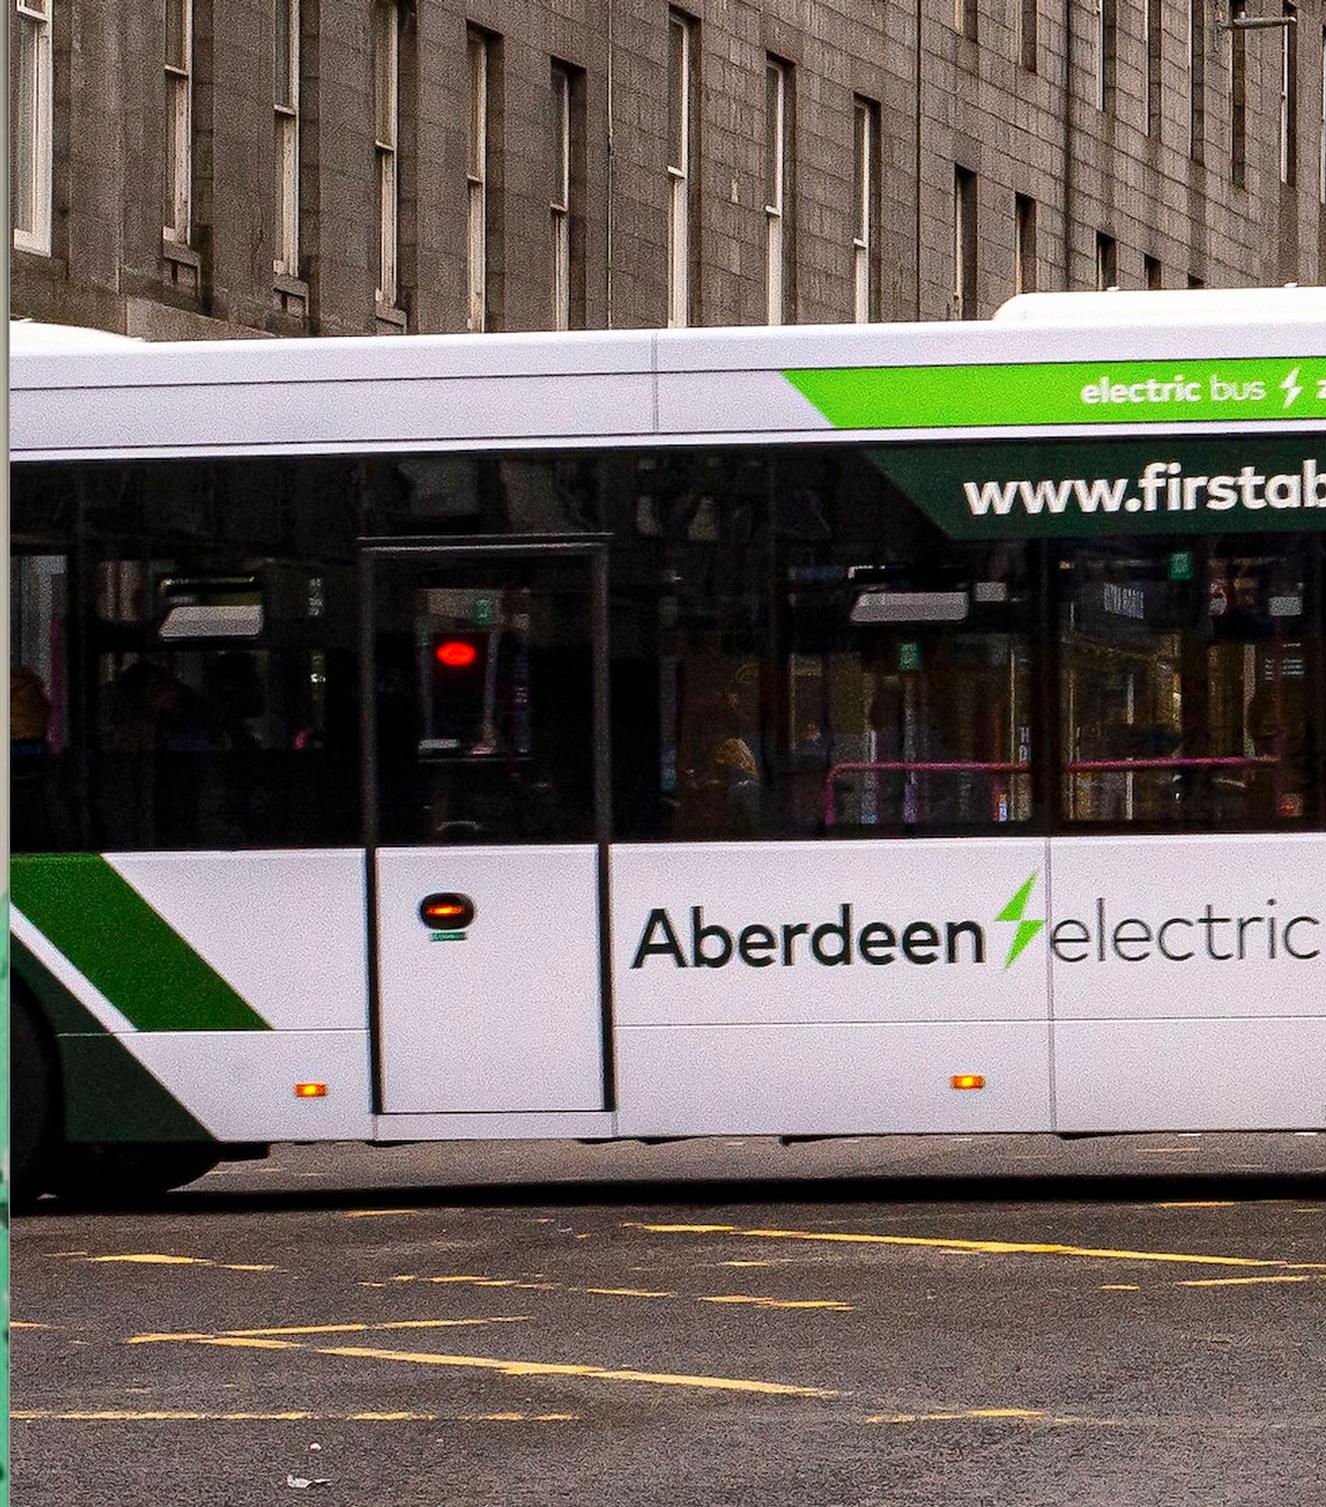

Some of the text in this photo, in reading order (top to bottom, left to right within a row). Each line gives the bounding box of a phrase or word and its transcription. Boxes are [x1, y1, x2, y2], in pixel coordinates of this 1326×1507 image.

[1081, 374, 1202, 404] electric
[1210, 373, 1267, 401] bus
[630, 898, 1321, 969] Aberdeen electric
